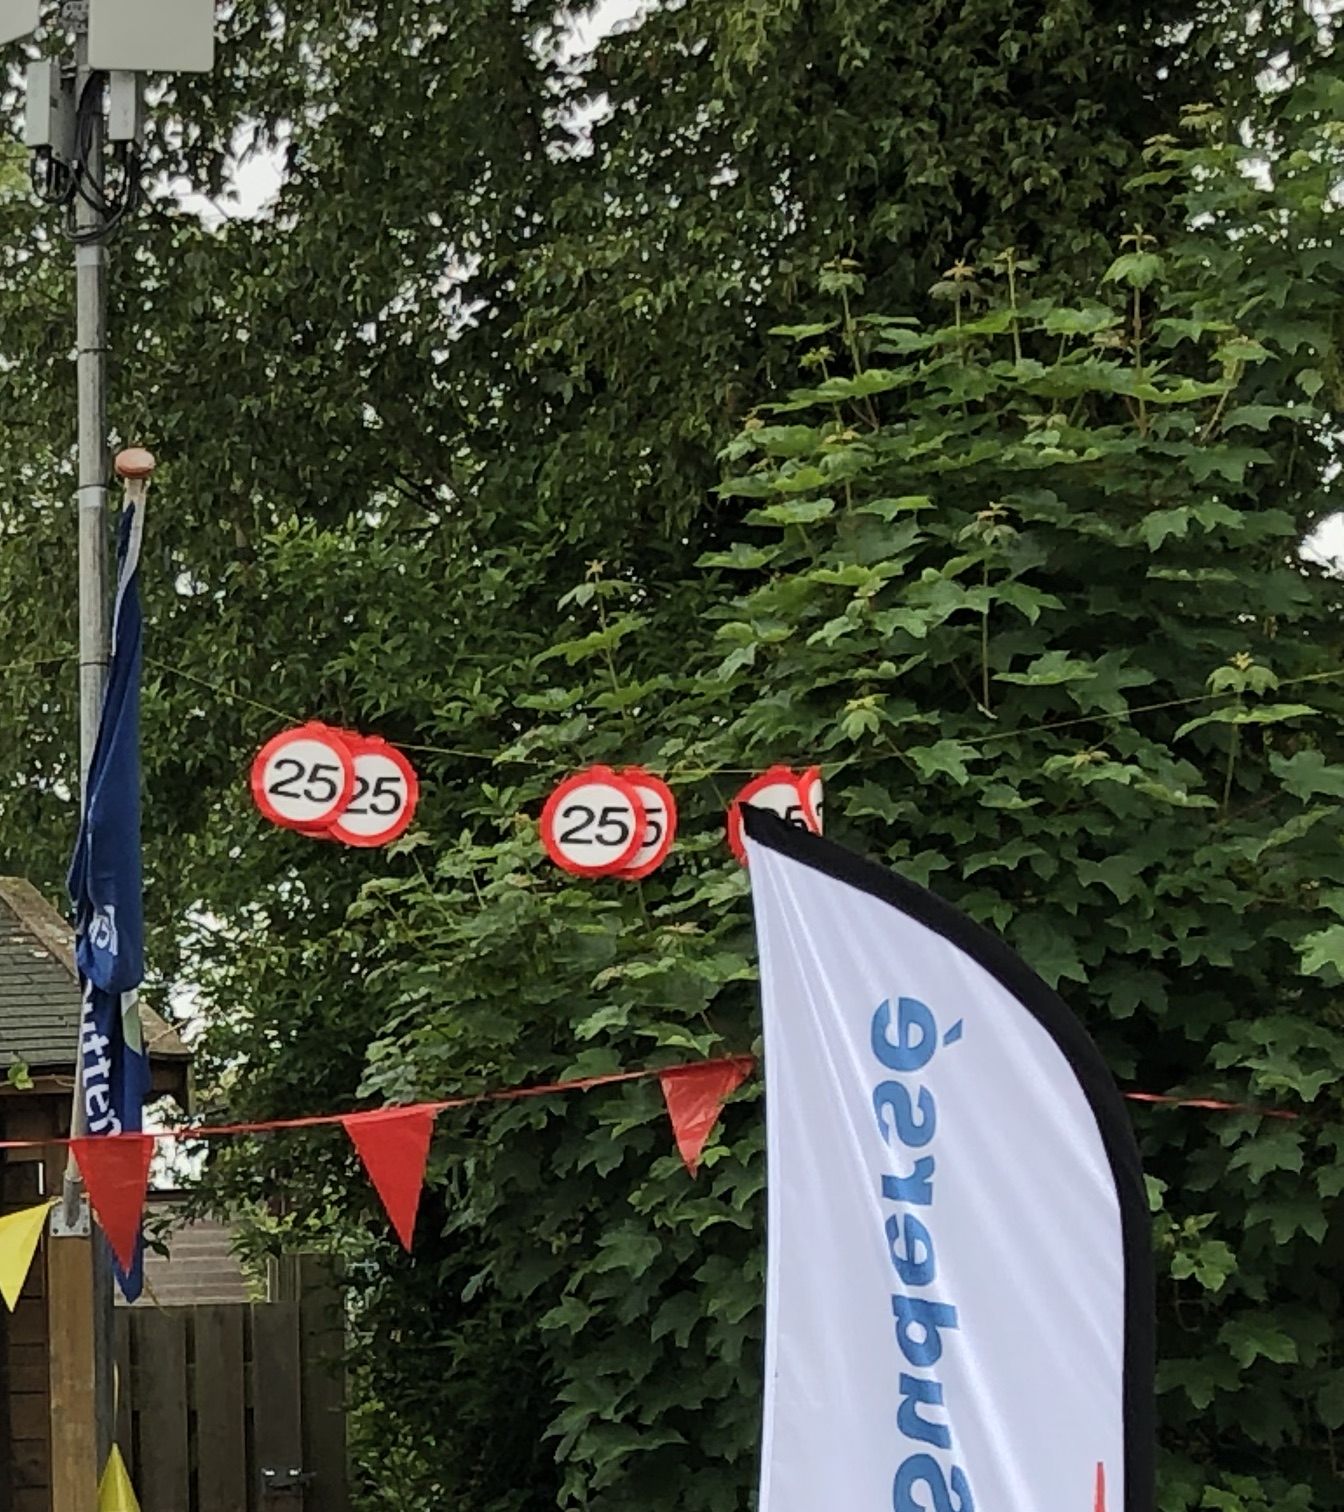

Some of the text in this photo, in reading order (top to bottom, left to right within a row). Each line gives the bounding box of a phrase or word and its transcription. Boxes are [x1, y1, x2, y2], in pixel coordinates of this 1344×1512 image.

[268, 758, 339, 803] 25
[560, 805, 630, 846] 25
[641, 808, 663, 847] 5
